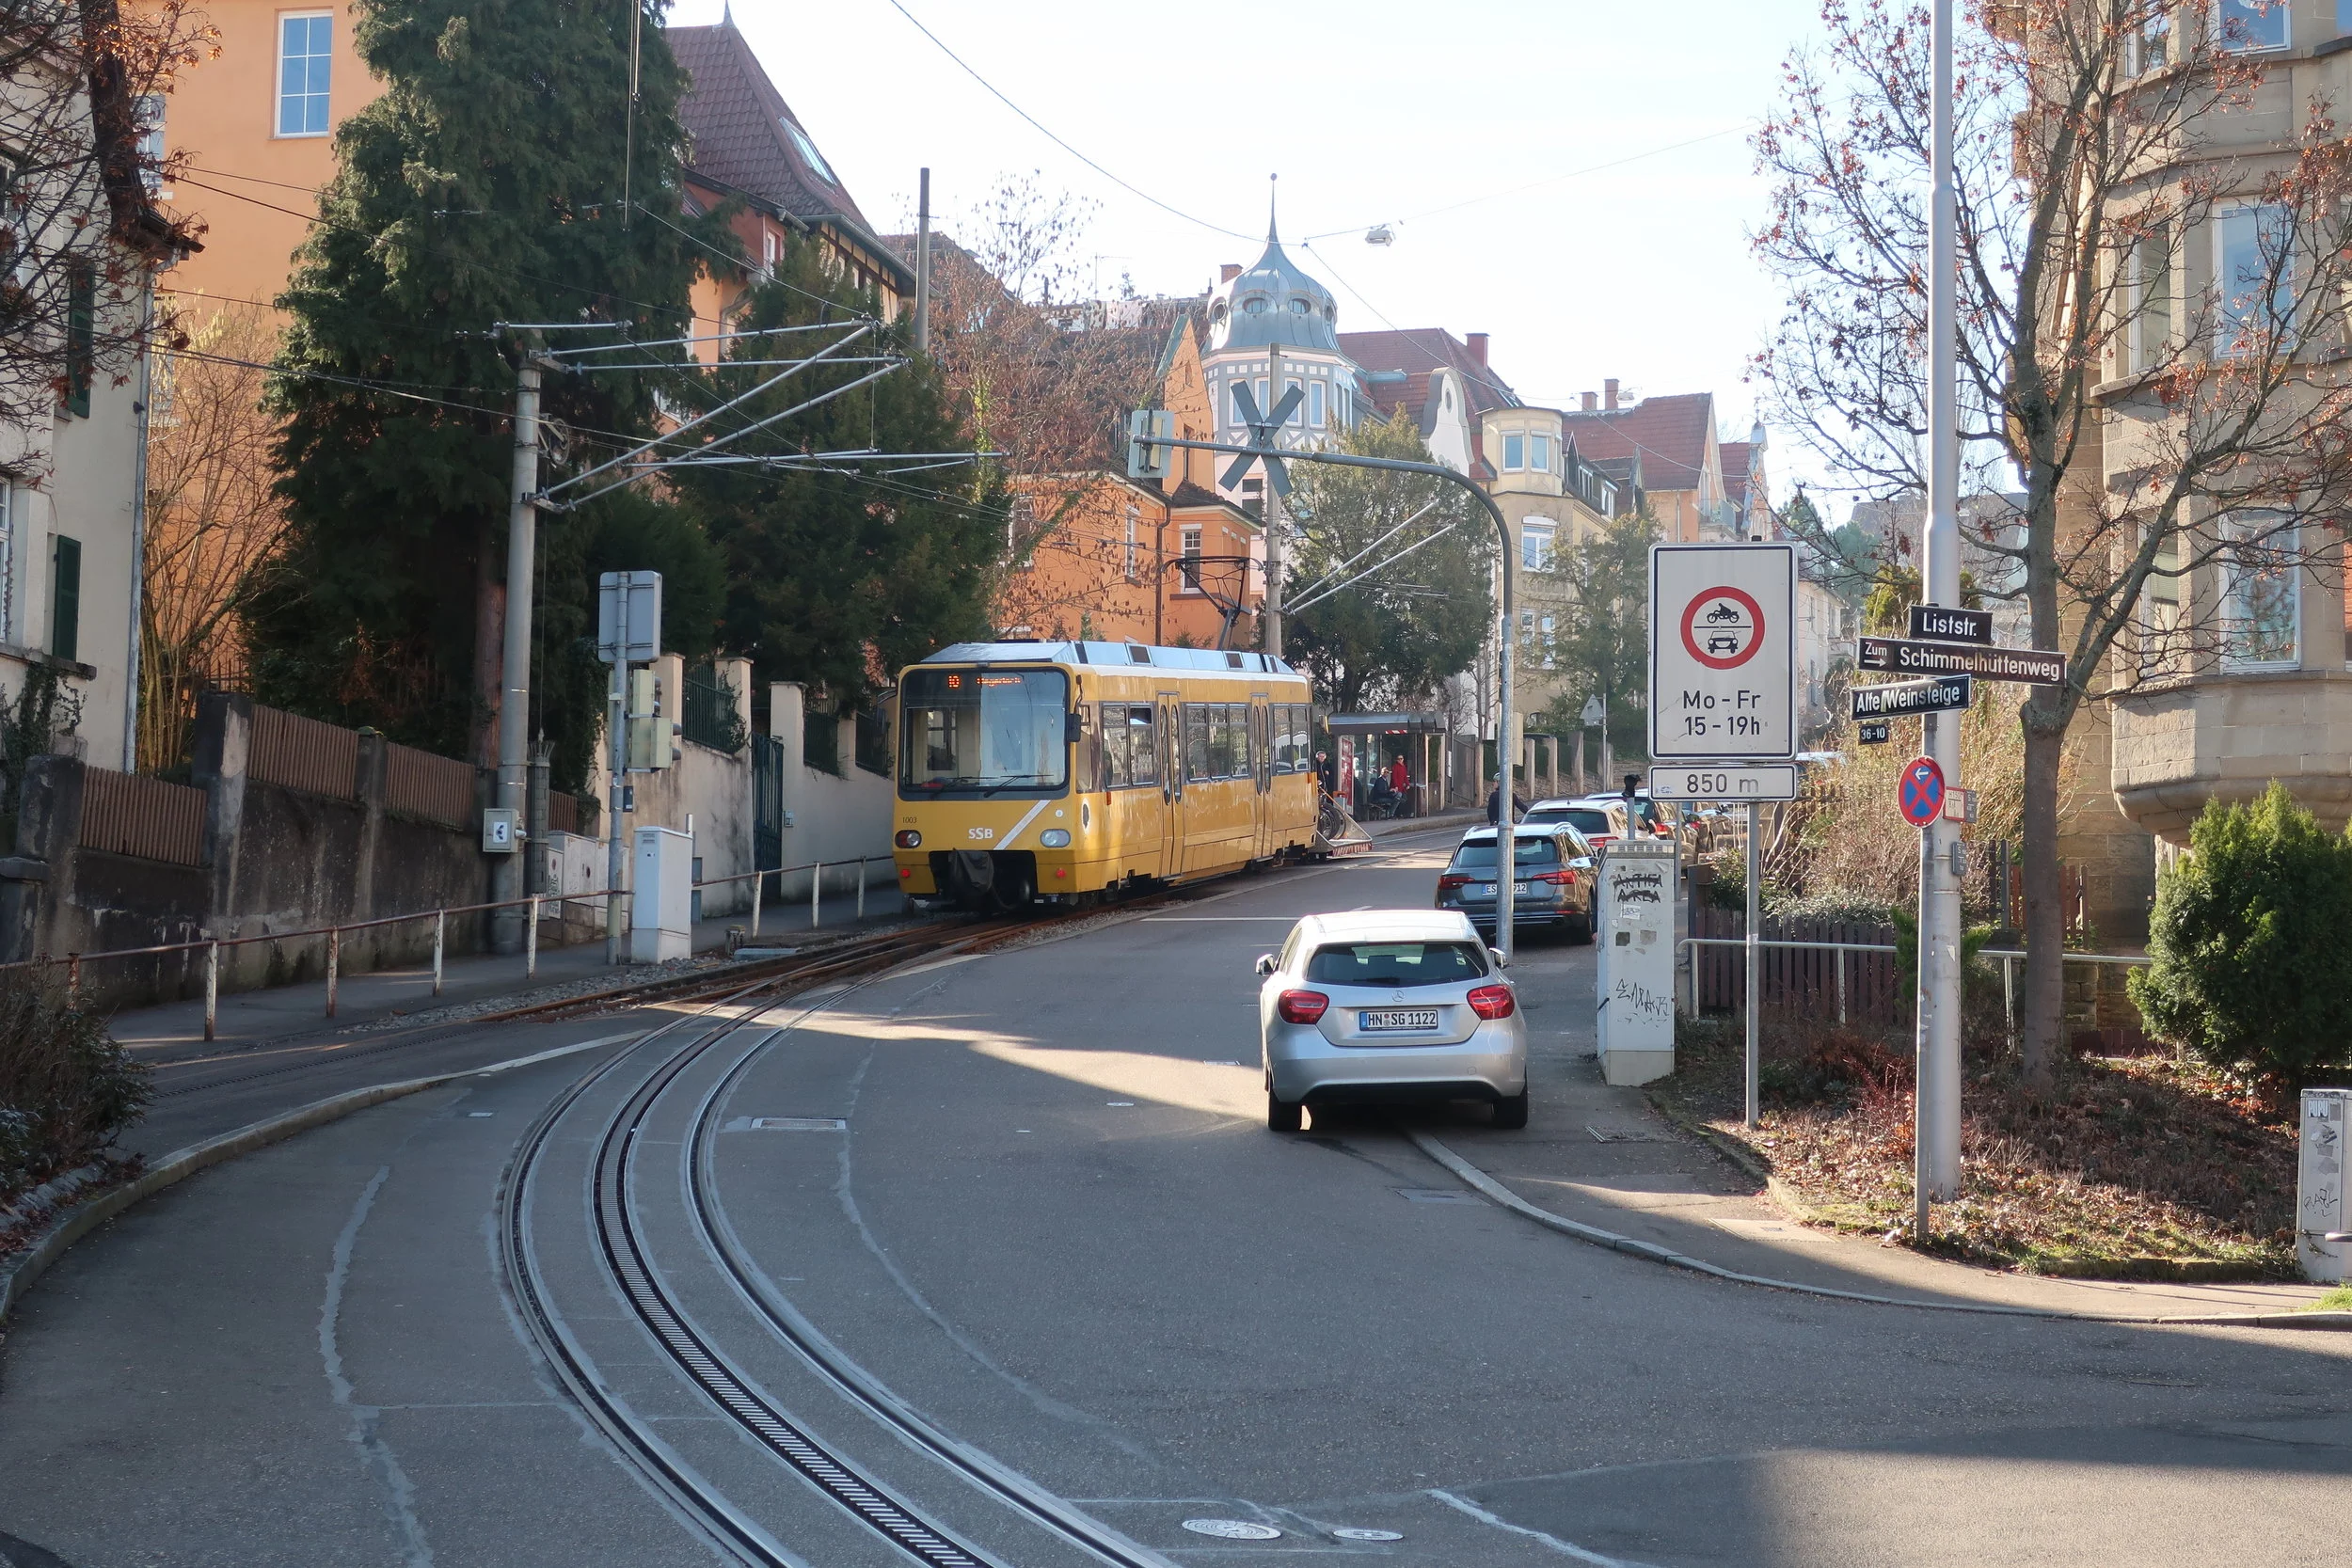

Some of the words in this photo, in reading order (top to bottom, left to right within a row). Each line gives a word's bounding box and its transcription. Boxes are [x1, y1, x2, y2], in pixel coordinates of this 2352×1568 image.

[1922, 611, 1978, 637] Liststr.
[1865, 641, 1887, 657] Zum
[1899, 646, 2060, 681] Schimmelhüttenweg
[1683, 689, 1715, 709] Mo
[1737, 689, 1761, 709] Fr
[1856, 692, 1881, 712] Alte
[1885, 685, 1961, 708] Weinsteige
[1684, 716, 1707, 736] 15
[1727, 715, 1760, 736] 19h
[1860, 727, 1885, 740] 36-10
[1687, 773, 1727, 793] 850
[1739, 778, 1759, 793] m
[968, 827, 993, 840] SSB
[1368, 1014, 1383, 1026] HN
[1391, 1013, 1406, 1025] SG
[1407, 1012, 1436, 1025] 1122
